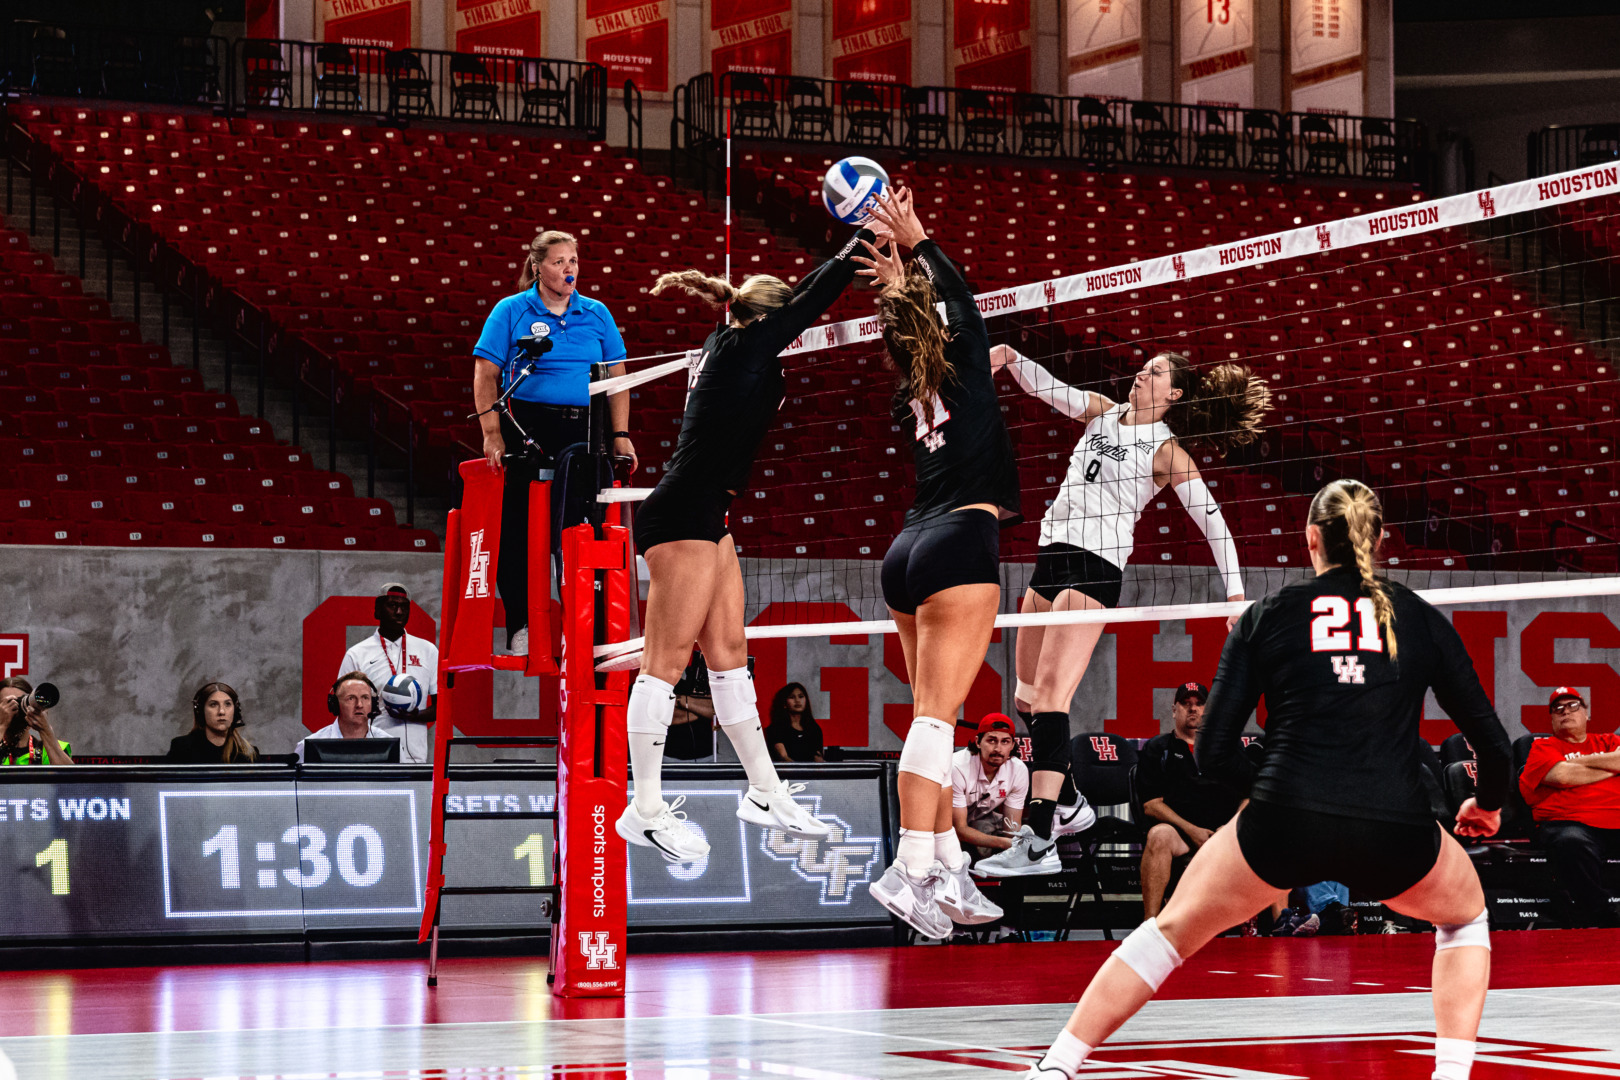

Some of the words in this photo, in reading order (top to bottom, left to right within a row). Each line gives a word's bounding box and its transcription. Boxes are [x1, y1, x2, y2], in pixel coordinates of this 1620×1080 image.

[463, 5, 498, 26] FINAL
[595, 13, 629, 34] FINAL
[631, 4, 661, 24] FOUR
[719, 23, 752, 45] FINAL
[754, 15, 784, 37] FOUR
[342, 37, 394, 48] HOUSTON
[473, 45, 524, 56] HOUSTON
[841, 33, 873, 54] FINAL
[875, 24, 904, 46] FOUR
[961, 41, 993, 64] FINAL
[603, 53, 652, 65] HOUSTON
[728, 64, 776, 75] HOUSTON
[850, 71, 897, 82] HOUSTON
[1538, 167, 1618, 201] HOUSTON
[1368, 206, 1439, 236] HOUSTON
[1219, 237, 1282, 266] HOUSTON
[1086, 267, 1142, 293] HOUSTON
[1085, 433, 1130, 462] Knights
[1310, 595, 1383, 652] 21
[1330, 655, 1366, 684] UH
[1089, 736, 1119, 761] UH
[58, 797, 131, 821] WON
[446, 795, 520, 813] SETS
[591, 805, 607, 854] sports
[36, 839, 71, 895] 1
[202, 824, 385, 889] 1:30
[513, 833, 547, 887] 1
[578, 931, 617, 970] UH
